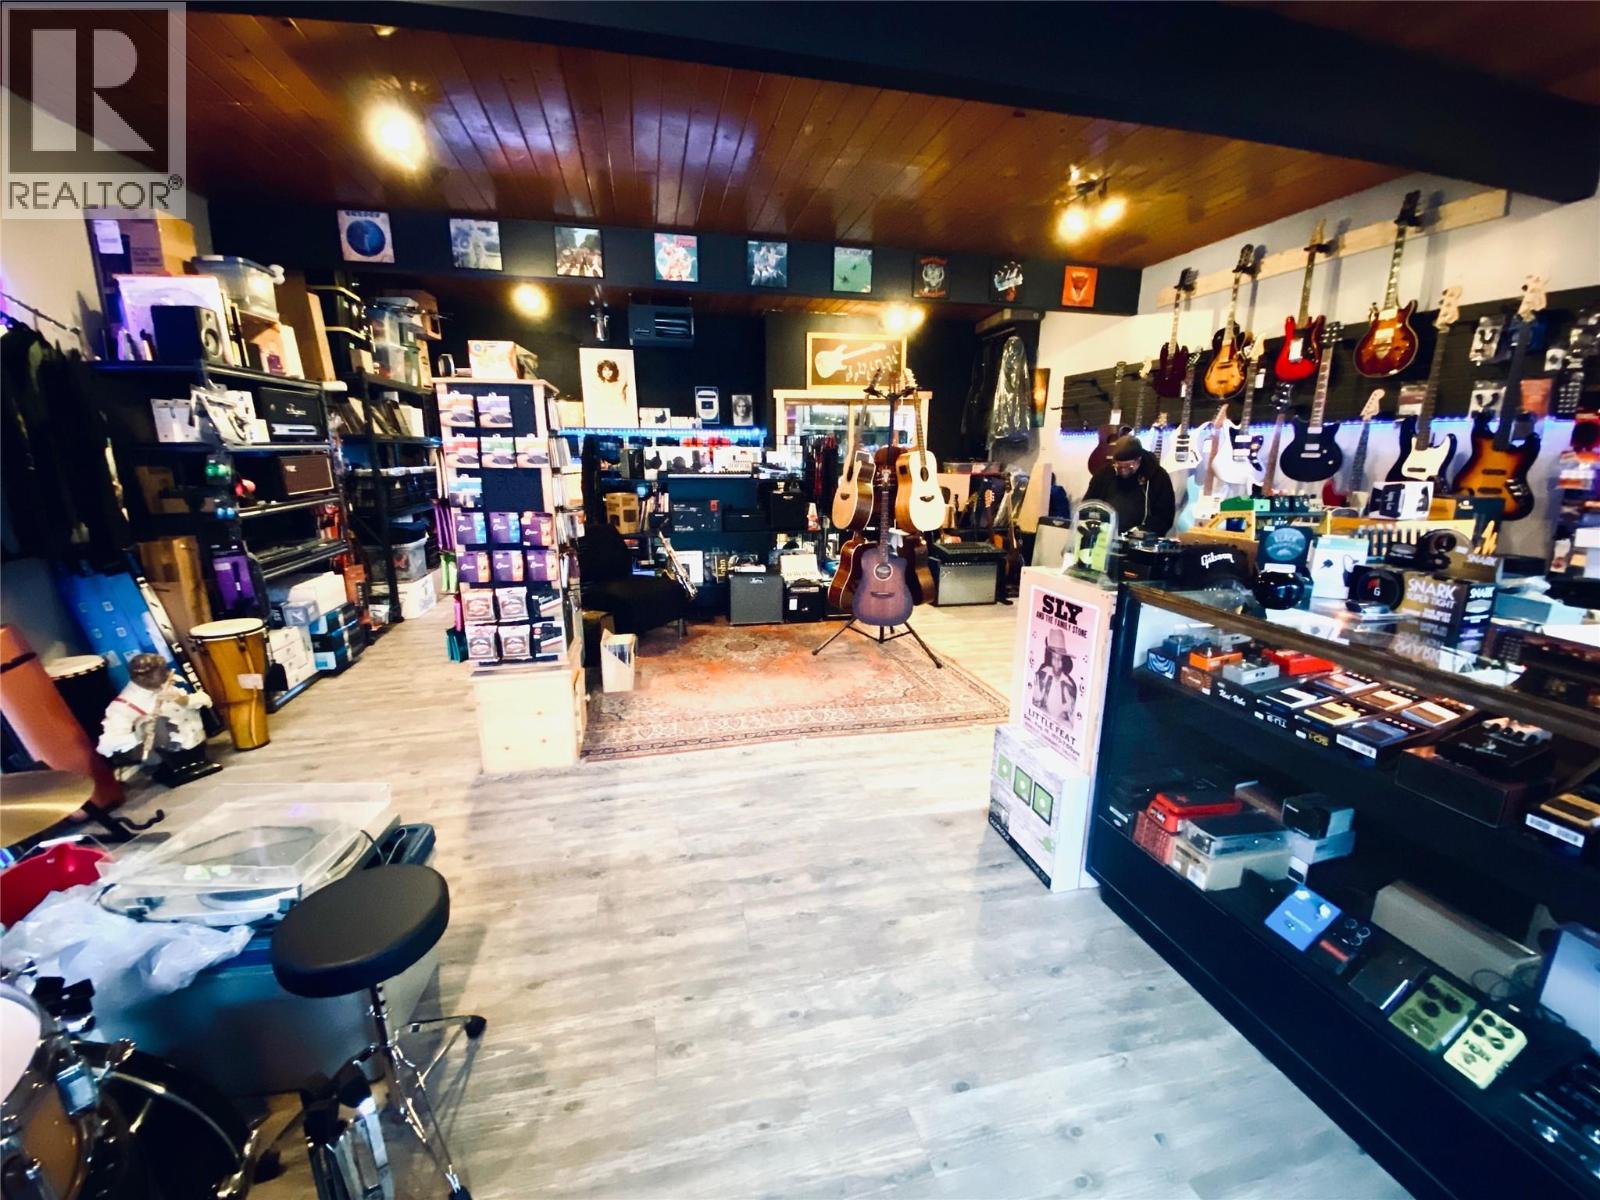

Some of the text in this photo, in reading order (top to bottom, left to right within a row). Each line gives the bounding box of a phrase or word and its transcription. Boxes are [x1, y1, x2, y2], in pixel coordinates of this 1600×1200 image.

[1200, 551, 1235, 569] Gibson
[1406, 578, 1457, 601] SNARK
[1431, 596, 1456, 609] TIGHT
[1042, 594, 1083, 625] SLY
[1036, 610, 1088, 639] AND THE FAMILY STONE
[1028, 707, 1053, 731] LITTLE
[1054, 726, 1076, 746] FEAT
